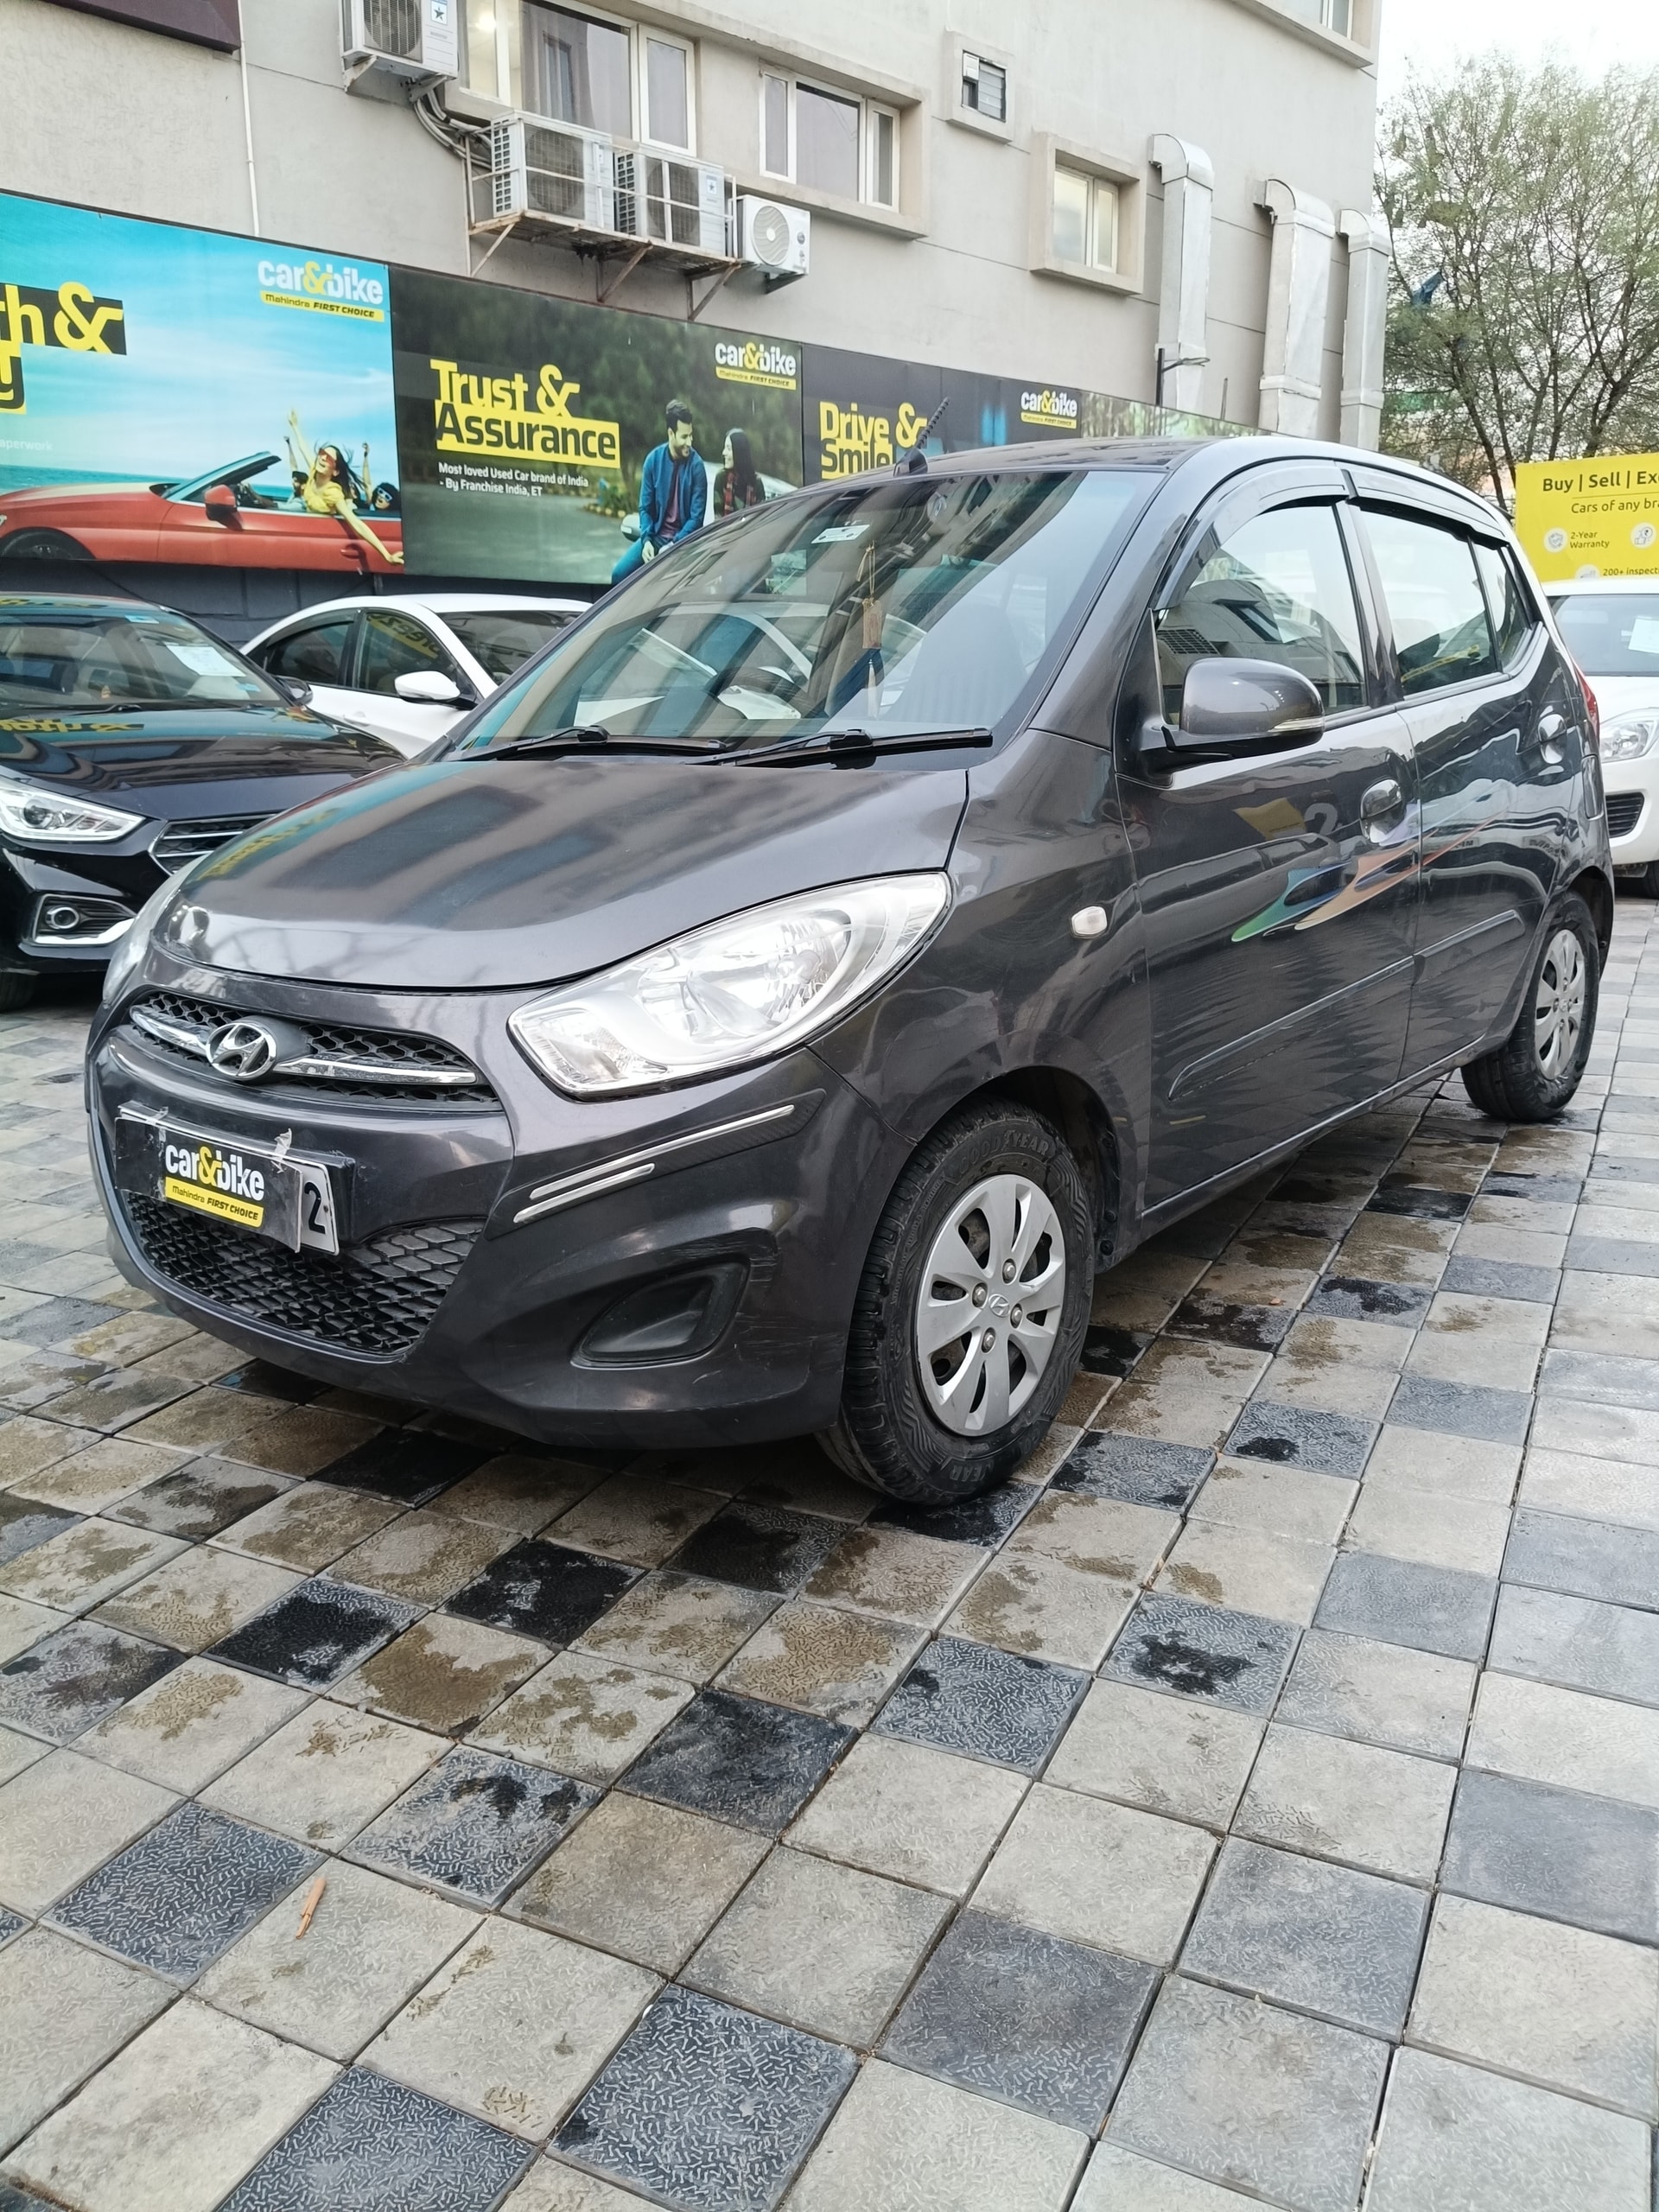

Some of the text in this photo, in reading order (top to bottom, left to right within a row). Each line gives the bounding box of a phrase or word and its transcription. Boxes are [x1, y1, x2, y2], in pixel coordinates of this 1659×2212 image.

[257, 260, 384, 305] car&bike
[265, 294, 375, 318] Mahindra FIRST CHOICE
[715, 341, 797, 377] car&bike
[430, 359, 581, 418] Trust &
[768, 378, 790, 387] CHOICE
[1020, 390, 1077, 417] car&bike
[435, 402, 616, 461] Assurance
[819, 401, 928, 448] Drive &
[821, 437, 891, 474] Smile
[438, 462, 589, 487] Most loved Used Car brand of India
[445, 478, 459, 491] By
[461, 480, 504, 493] Franchise
[505, 485, 530, 497] India,
[531, 486, 543, 497] ET
[1542, 478, 1573, 493] Buy
[1588, 471, 1621, 488] Sell
[1571, 503, 1598, 513] Cars
[1601, 499, 1616, 512] of
[1618, 501, 1640, 512] any
[1569, 540, 1610, 549] Warranty
[1570, 531, 1598, 540] 2-Year
[1603, 568, 1624, 576] 200+
[165, 1145, 264, 1201] car&bike
[172, 1185, 258, 1220] Mahindra FIRST CHOICE
[303, 1181, 327, 1235] 2
